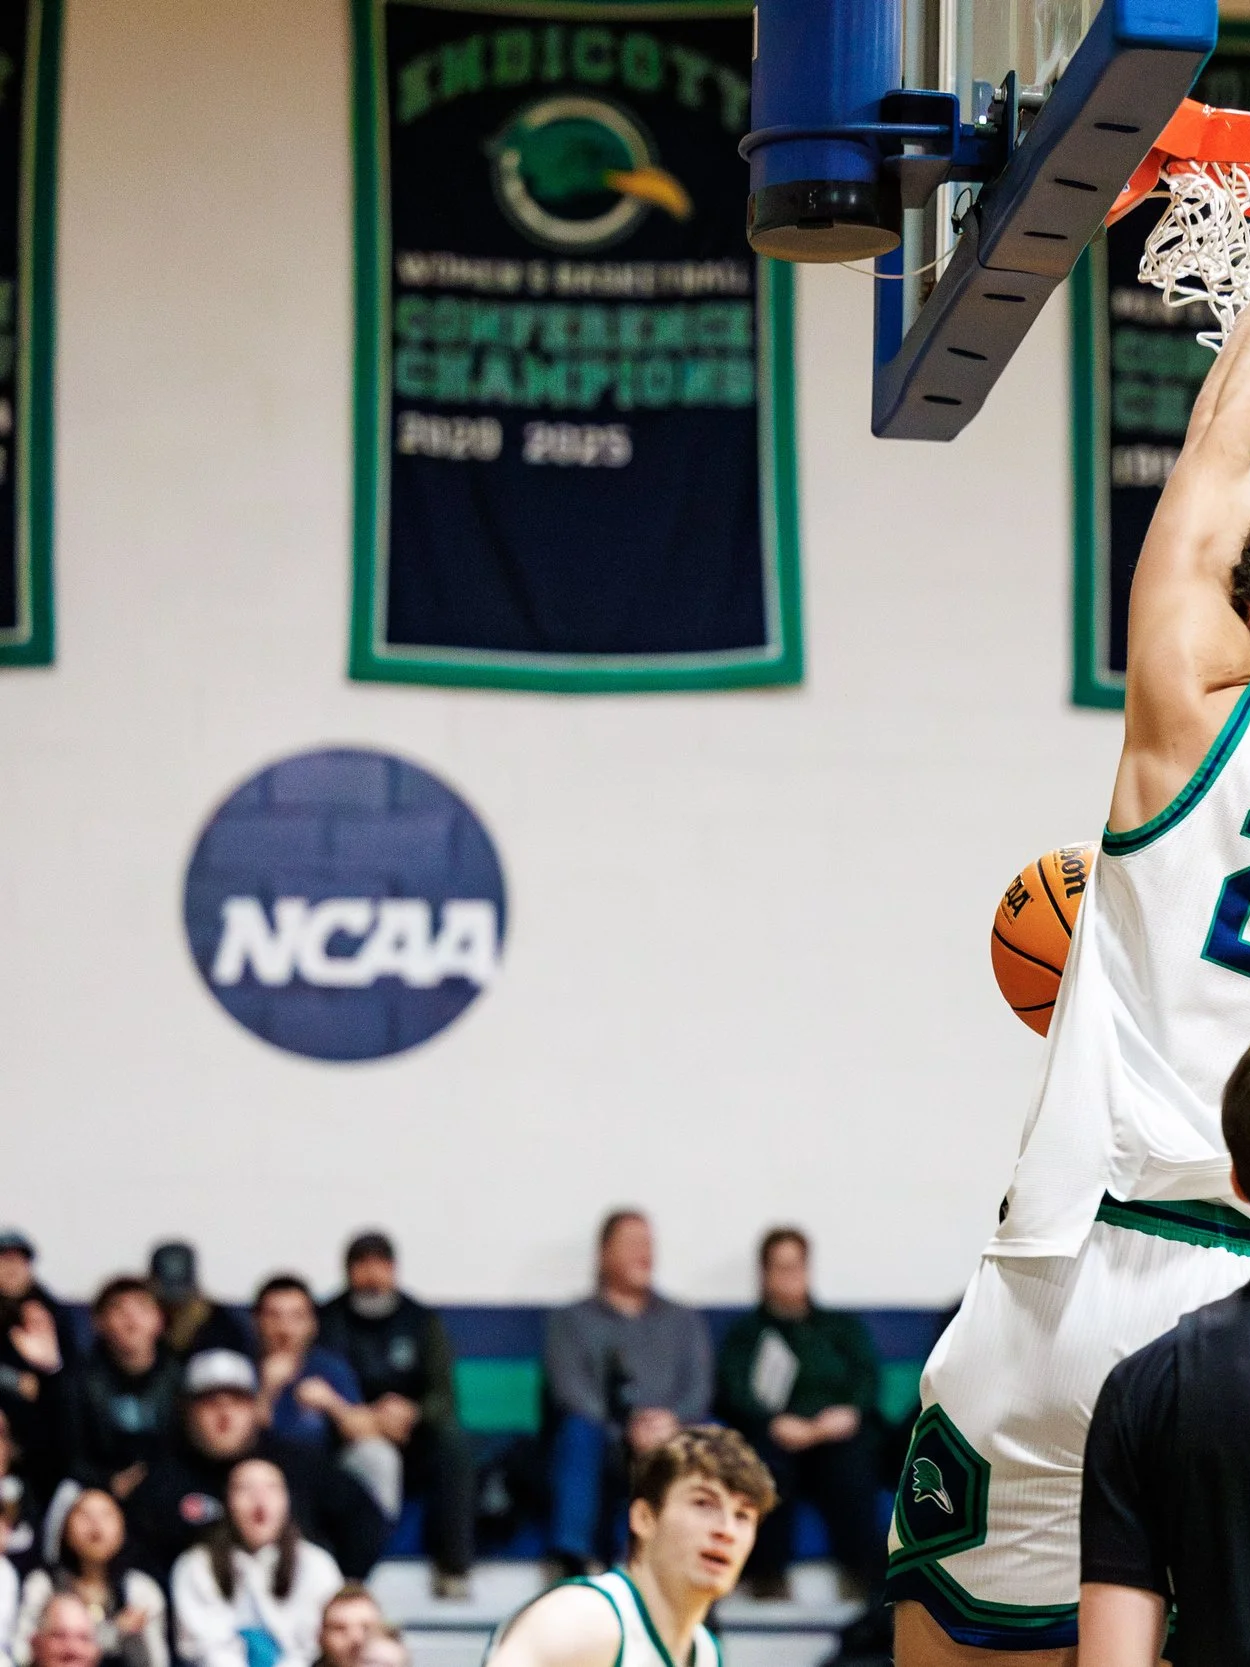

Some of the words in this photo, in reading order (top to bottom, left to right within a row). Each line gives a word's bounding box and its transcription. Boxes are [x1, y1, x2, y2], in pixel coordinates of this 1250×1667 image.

[402, 24, 751, 128] ENDICOTT
[398, 297, 751, 350] CONFERENCE
[398, 350, 754, 409] CHAMPIONS
[213, 896, 500, 990] NCAA
